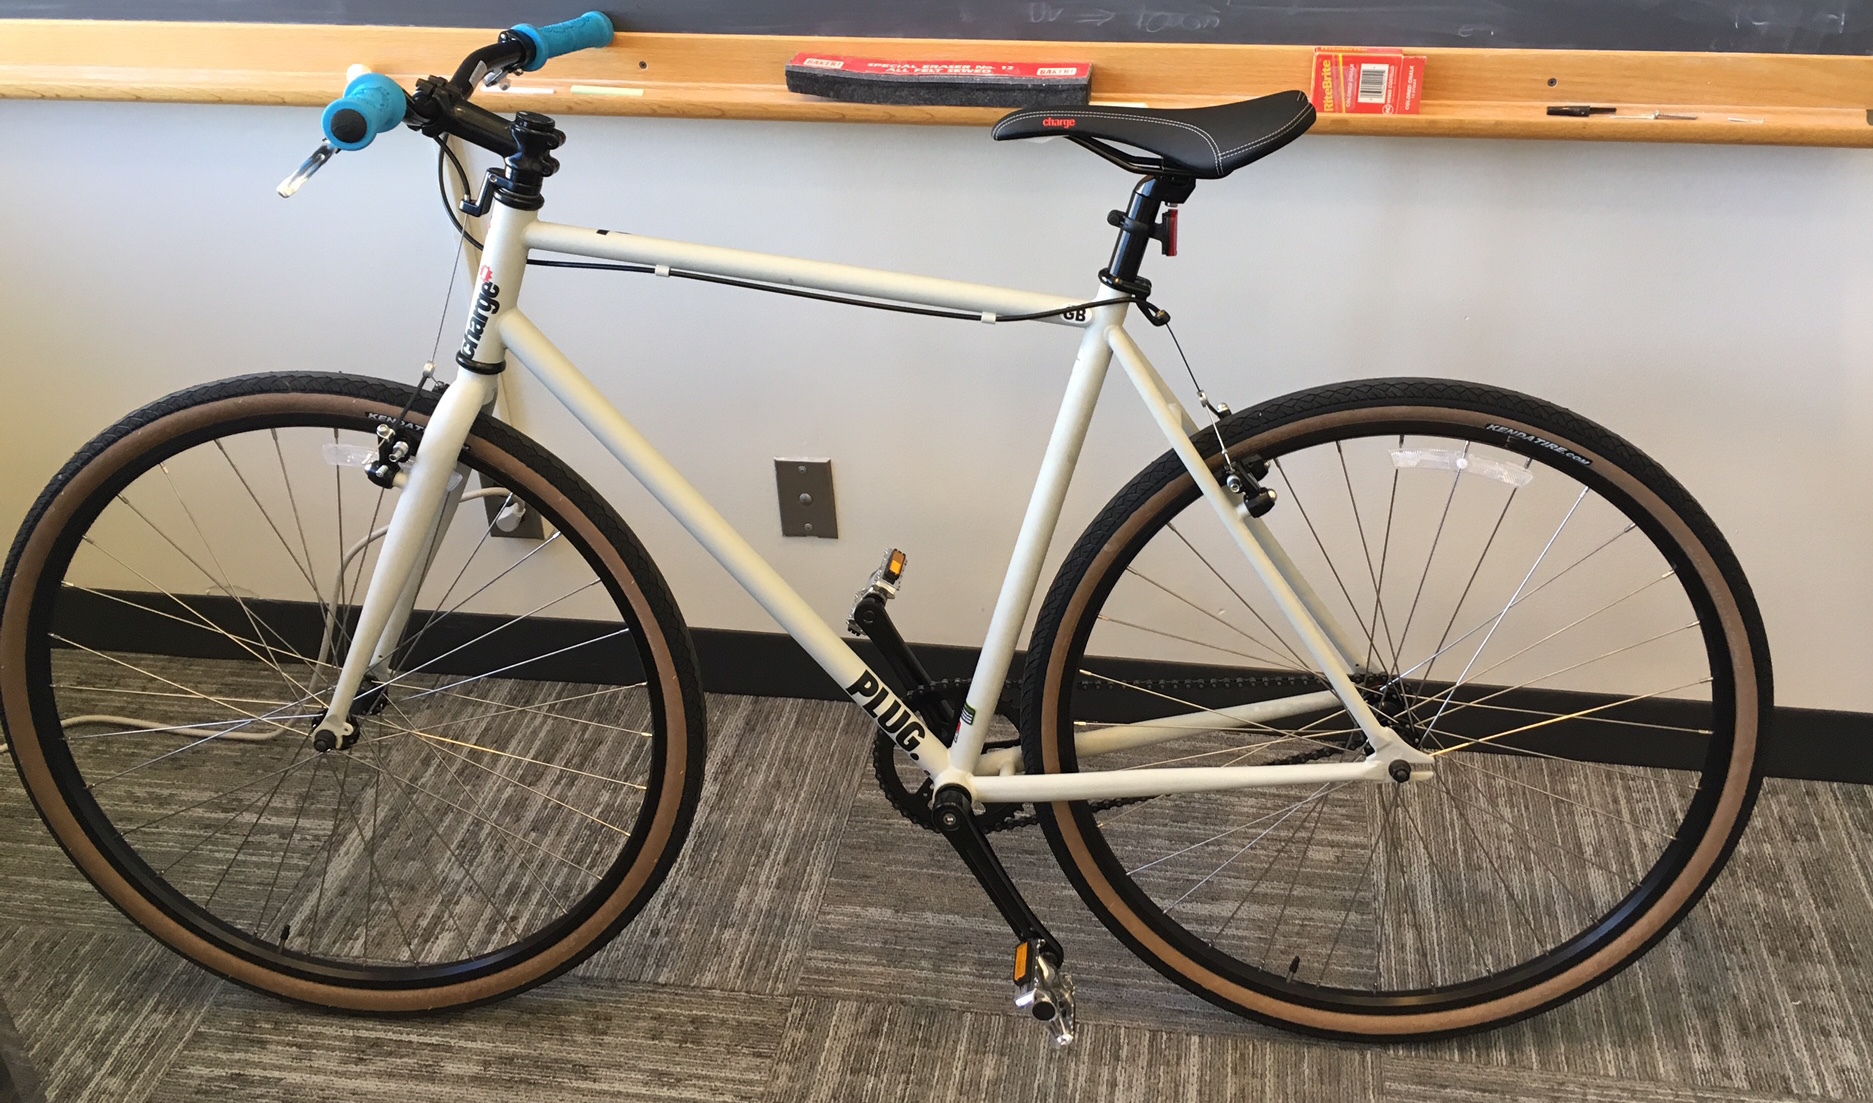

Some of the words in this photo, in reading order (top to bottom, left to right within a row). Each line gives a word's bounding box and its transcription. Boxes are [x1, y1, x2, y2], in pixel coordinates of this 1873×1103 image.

[1322, 59, 1334, 112] RiteBrite
[1407, 65, 1415, 84] CHALK
[1345, 82, 1353, 108] COLORED
[1404, 85, 1412, 111] COLORED
[1042, 117, 1076, 129] charge
[460, 281, 500, 360] charge
[1063, 306, 1086, 322] GB
[845, 669, 926, 761] PLUG.
